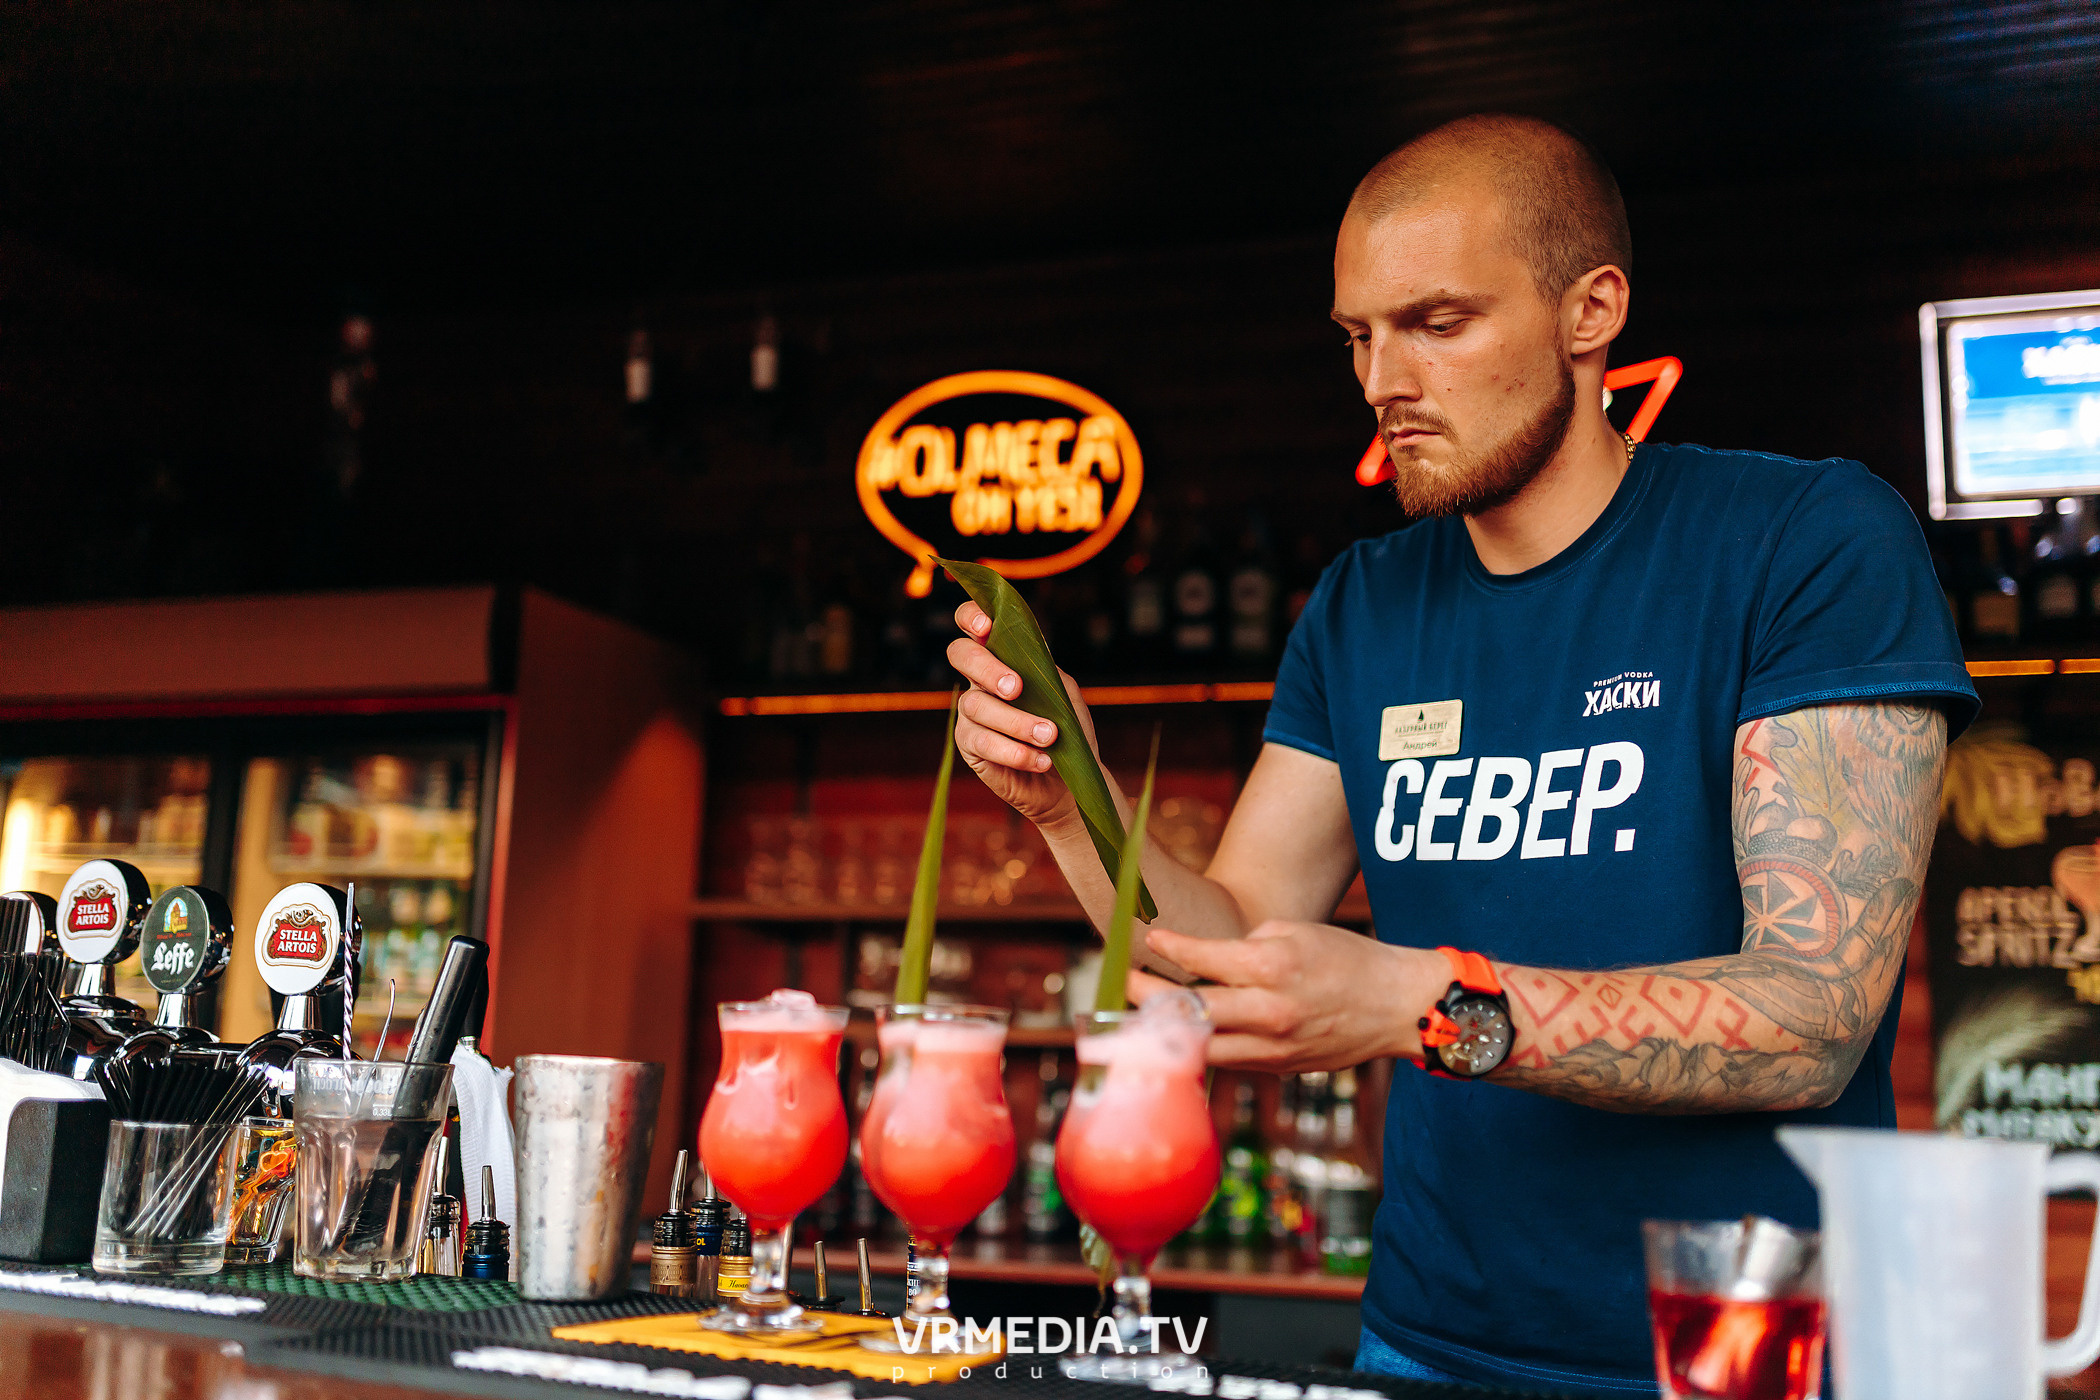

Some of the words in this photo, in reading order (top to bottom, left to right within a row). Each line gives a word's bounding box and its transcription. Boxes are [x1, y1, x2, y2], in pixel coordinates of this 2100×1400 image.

[1593, 673, 1623, 688] PREMIUM
[1624, 671, 1654, 679] VODKA
[1582, 680, 1661, 717] ХАСКИ
[1402, 739, 1438, 751] Андрей
[1374, 740, 1645, 862] СЕВЕР.
[77, 903, 110, 915] STELLA
[76, 914, 109, 926] ARTOIS
[279, 929, 318, 942] STELLA
[277, 941, 317, 954] ARTOIS
[150, 941, 195, 975] Leffe
